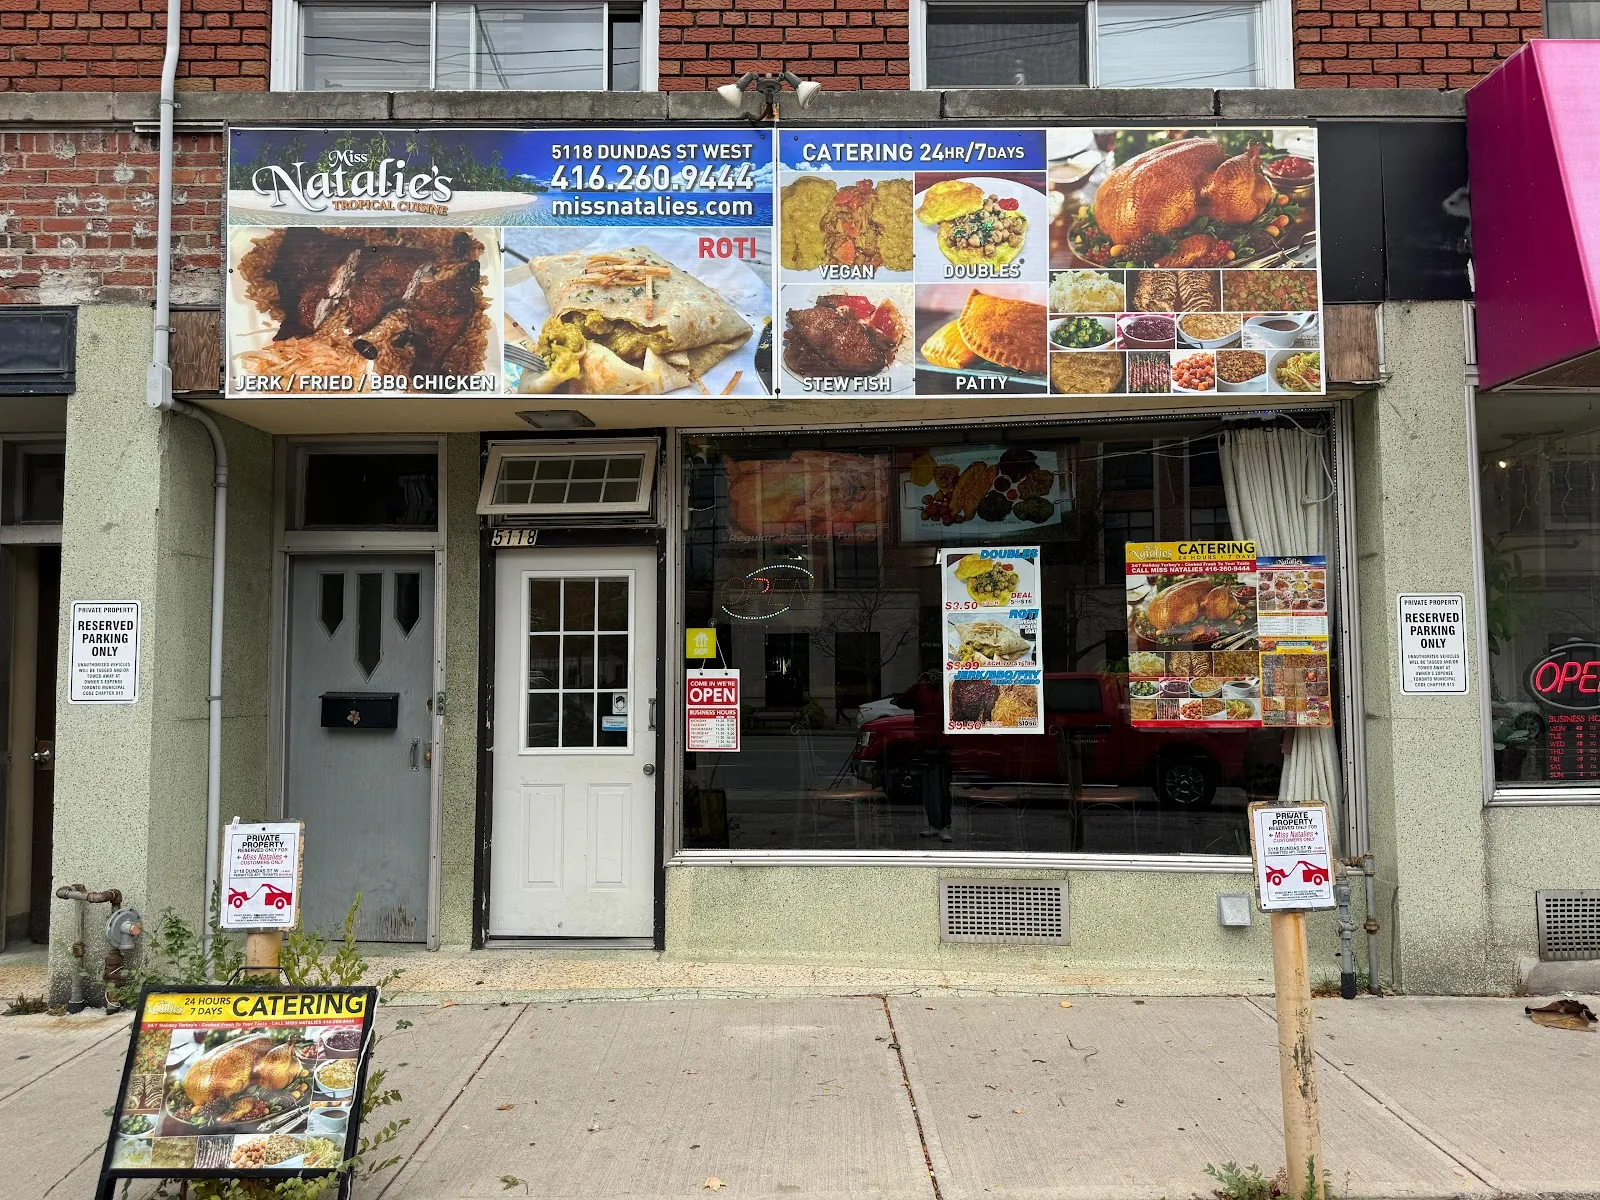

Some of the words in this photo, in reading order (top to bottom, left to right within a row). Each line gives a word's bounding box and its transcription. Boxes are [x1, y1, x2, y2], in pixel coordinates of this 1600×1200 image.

[551, 143, 593, 159] 5118
[597, 143, 671, 160] DUNDAS
[675, 144, 699, 160] ST
[702, 143, 753, 160] WEST
[803, 143, 913, 164] CATERING
[919, 143, 1025, 163] 24HR/7DAYS
[328, 149, 368, 168] Miss
[551, 164, 754, 192] 416.260.9444
[252, 158, 453, 212] Natalie's
[332, 199, 396, 213] TROPICAL
[396, 202, 449, 216] CUISINE
[552, 195, 754, 218] missnatalies.com
[698, 236, 757, 259] ROTI
[818, 263, 875, 280] VEGAN
[943, 262, 1020, 280] DOUBLES
[235, 374, 283, 392] JERK
[285, 374, 296, 392] /
[299, 374, 354, 392] FRIED
[357, 374, 368, 392] /
[370, 374, 409, 393] BBQ
[412, 374, 496, 392] CHICKEN
[803, 376, 848, 393] STEW
[853, 376, 892, 392] FISH
[956, 376, 1008, 392] PATTY
[493, 530, 537, 545] 5118
[728, 533, 775, 544] Regular
[834, 532, 879, 543] Turkey
[980, 549, 1039, 559] DOUBLES
[1178, 542, 1255, 554] CATERING
[945, 602, 978, 610] $3.50
[1008, 609, 1040, 619] ROTI
[1405, 613, 1460, 623] RESERVED
[78, 620, 134, 631] RESERVED
[1410, 626, 1456, 636] PARKING
[82, 633, 129, 644] PARKING
[1420, 638, 1447, 649] ONLY
[91, 646, 119, 657] ONLY
[693, 648, 708, 656] SKIP
[1535, 661, 1600, 693] OPE
[689, 687, 736, 703] OPEN
[1548, 715, 1586, 723] BUSINESS
[1272, 818, 1313, 826] PROPERTY
[246, 834, 280, 842] PRIVATE
[242, 841, 285, 849] PROPERTY
[184, 997, 196, 1005] 24
[198, 997, 231, 1005] HOURS
[232, 993, 363, 1016] CATERING
[198, 1007, 223, 1015] DAYS
